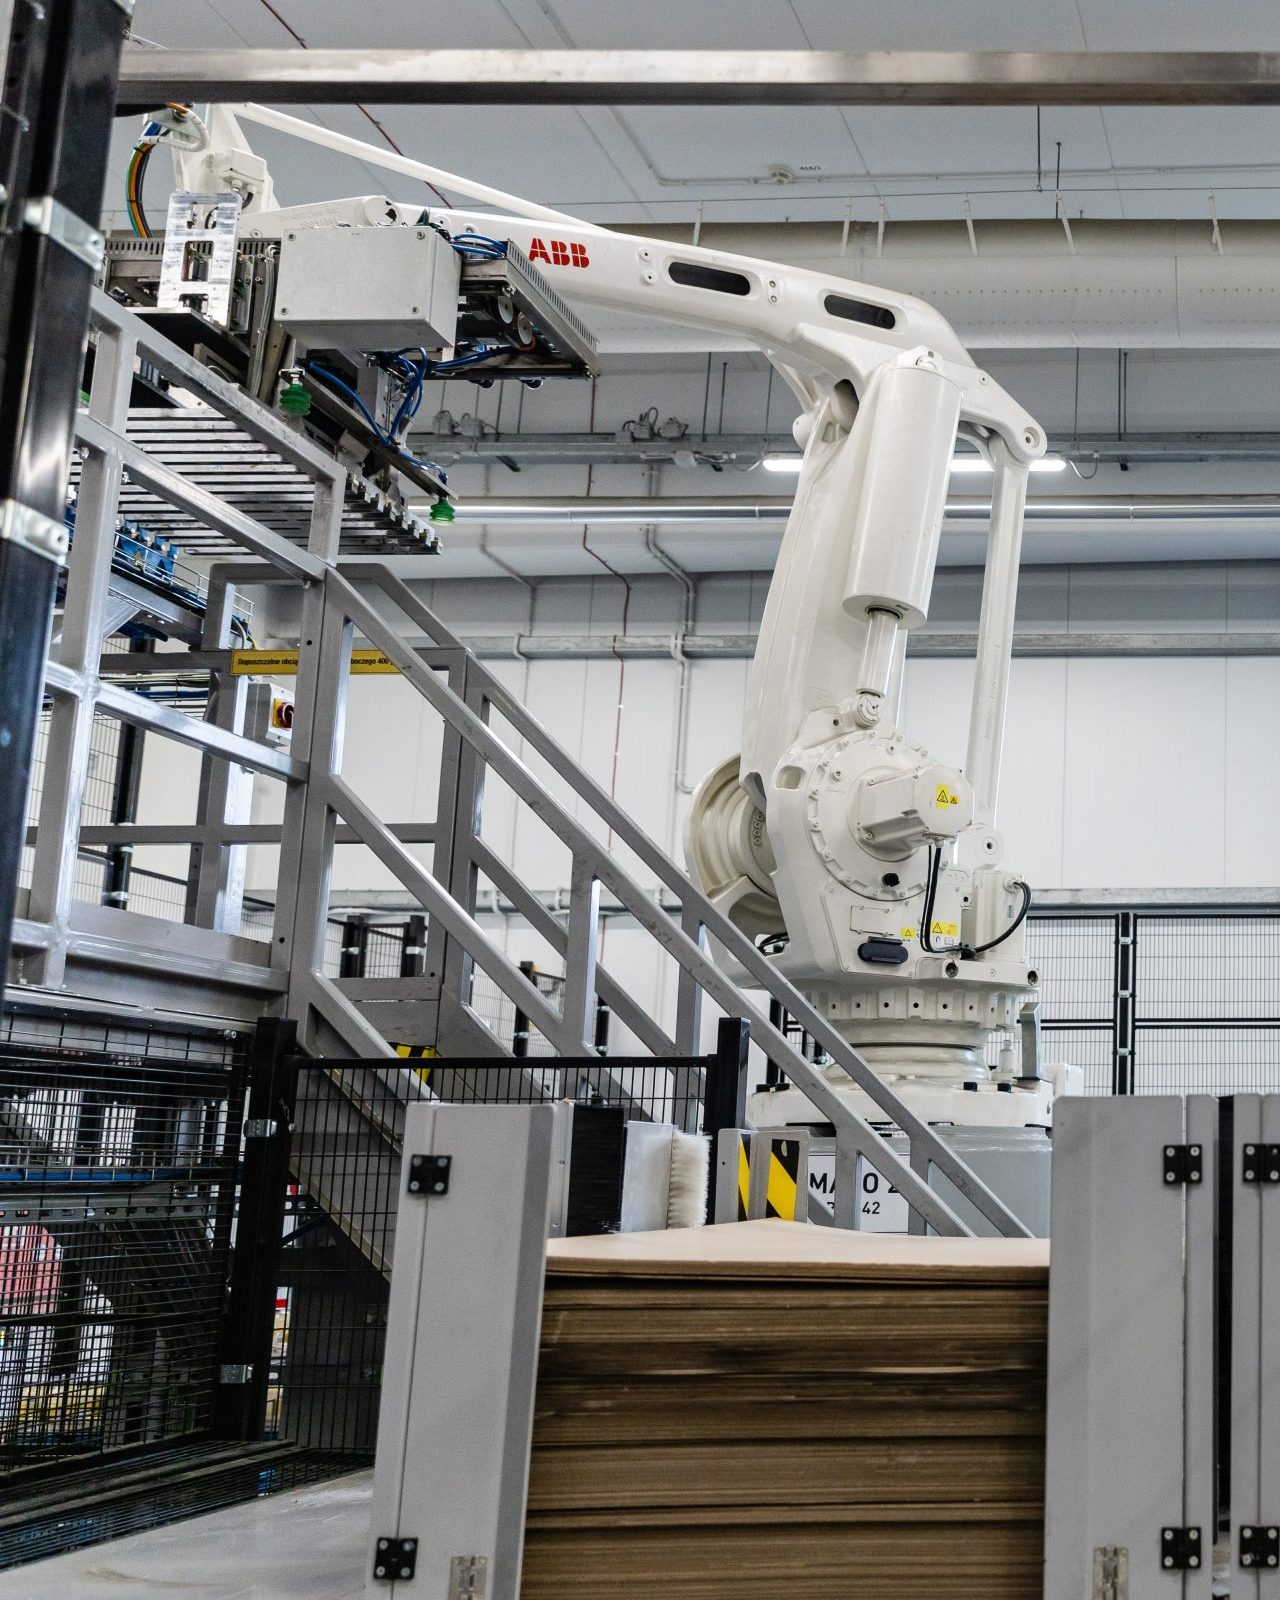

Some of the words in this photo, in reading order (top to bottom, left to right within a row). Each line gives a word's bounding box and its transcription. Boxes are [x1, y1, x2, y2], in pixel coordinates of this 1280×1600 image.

[528, 237, 590, 268] ABB
[809, 1172, 879, 1194] MO
[862, 1201, 881, 1215] 42
